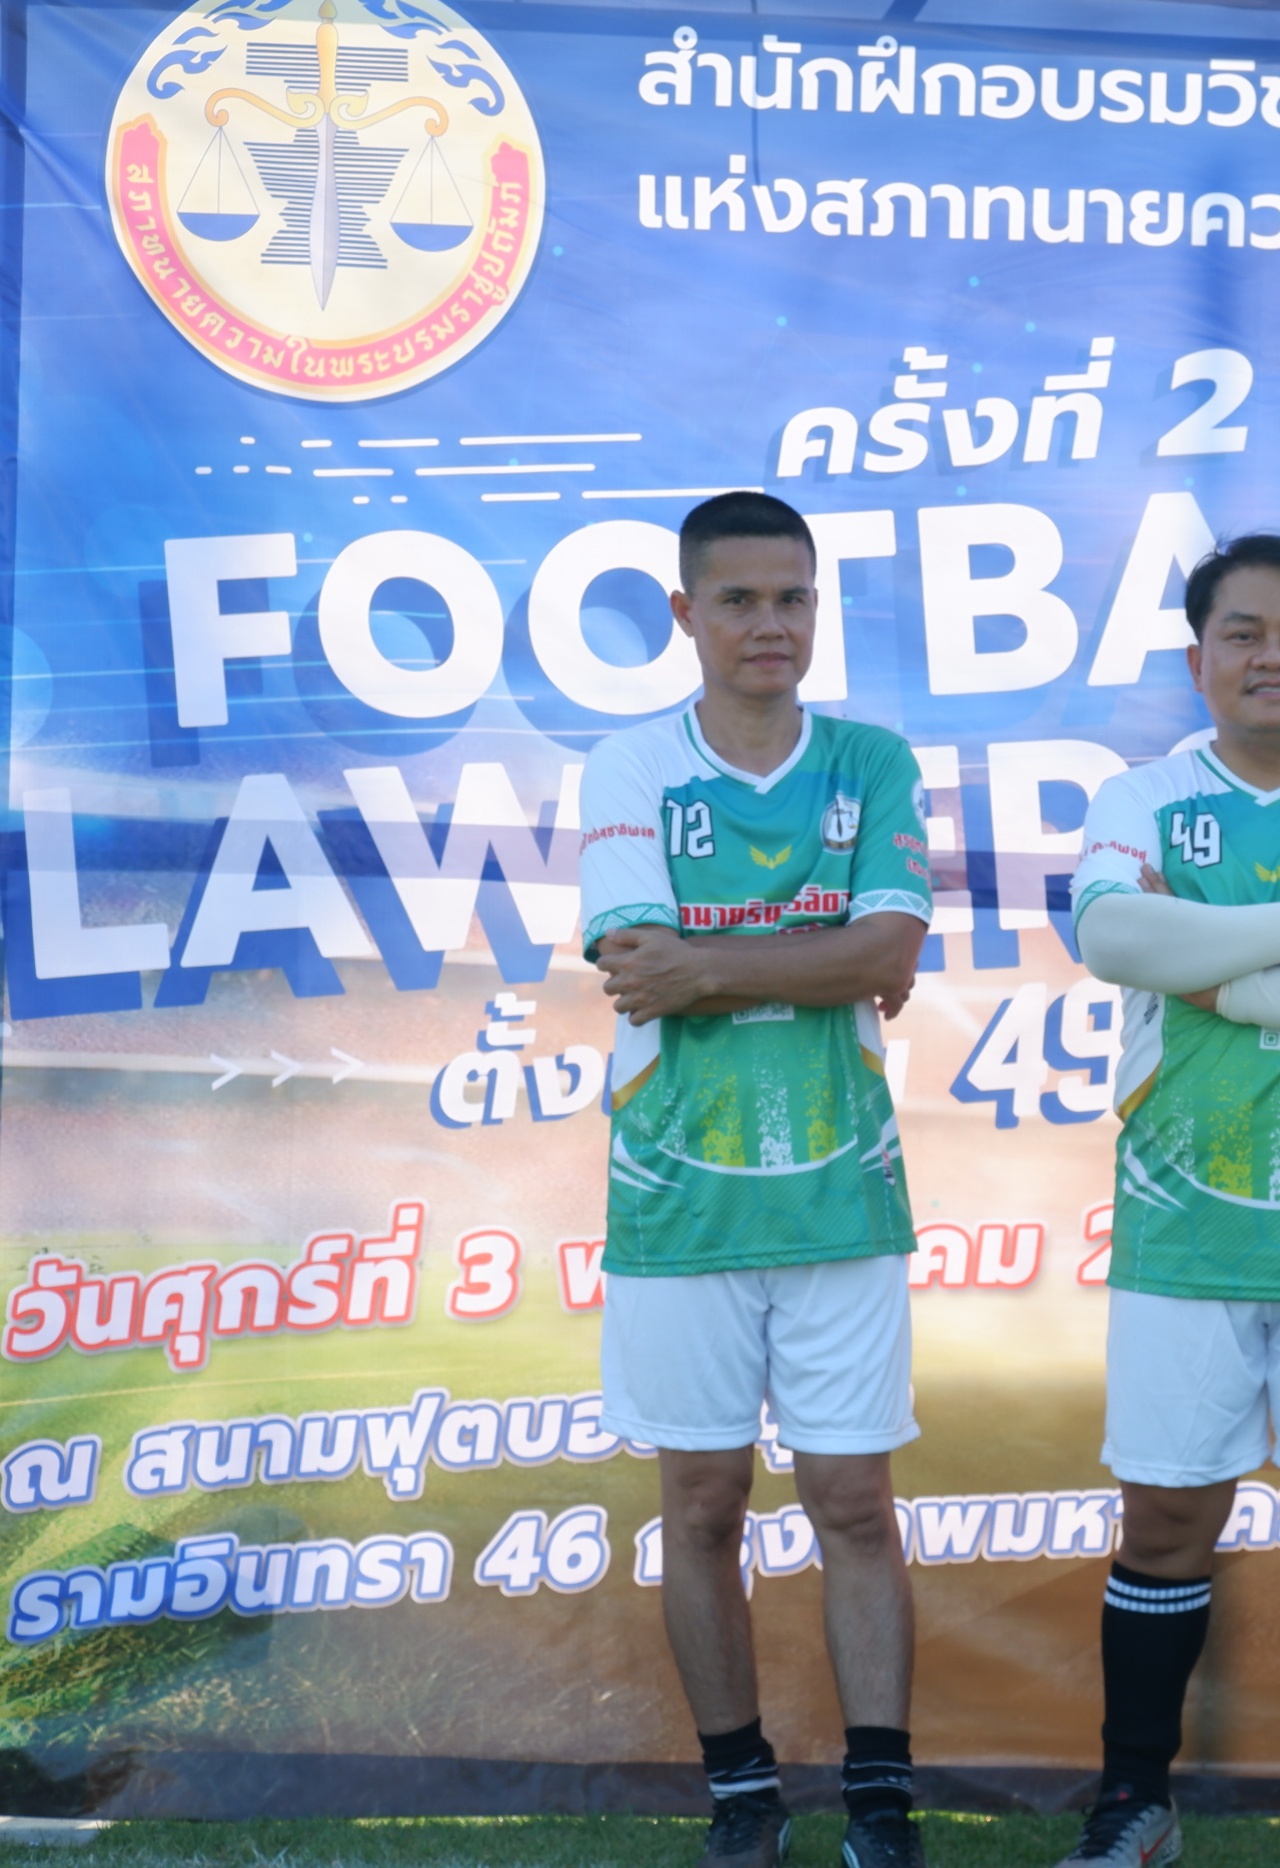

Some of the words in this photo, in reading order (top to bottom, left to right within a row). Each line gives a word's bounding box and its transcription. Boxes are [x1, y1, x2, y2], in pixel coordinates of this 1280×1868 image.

[776, 336, 1115, 477] ครั้งที่
[1155, 347, 1254, 457] 2
[1170, 811, 1222, 869] 49
[964, 977, 1127, 1120] 49
[6, 1202, 425, 1368] วันศุกร์ที่
[448, 1229, 520, 1318] 3
[1, 1437, 99, 1511] ณ
[8, 1533, 452, 1643] รามอินทรา
[476, 1506, 610, 1596] 46
